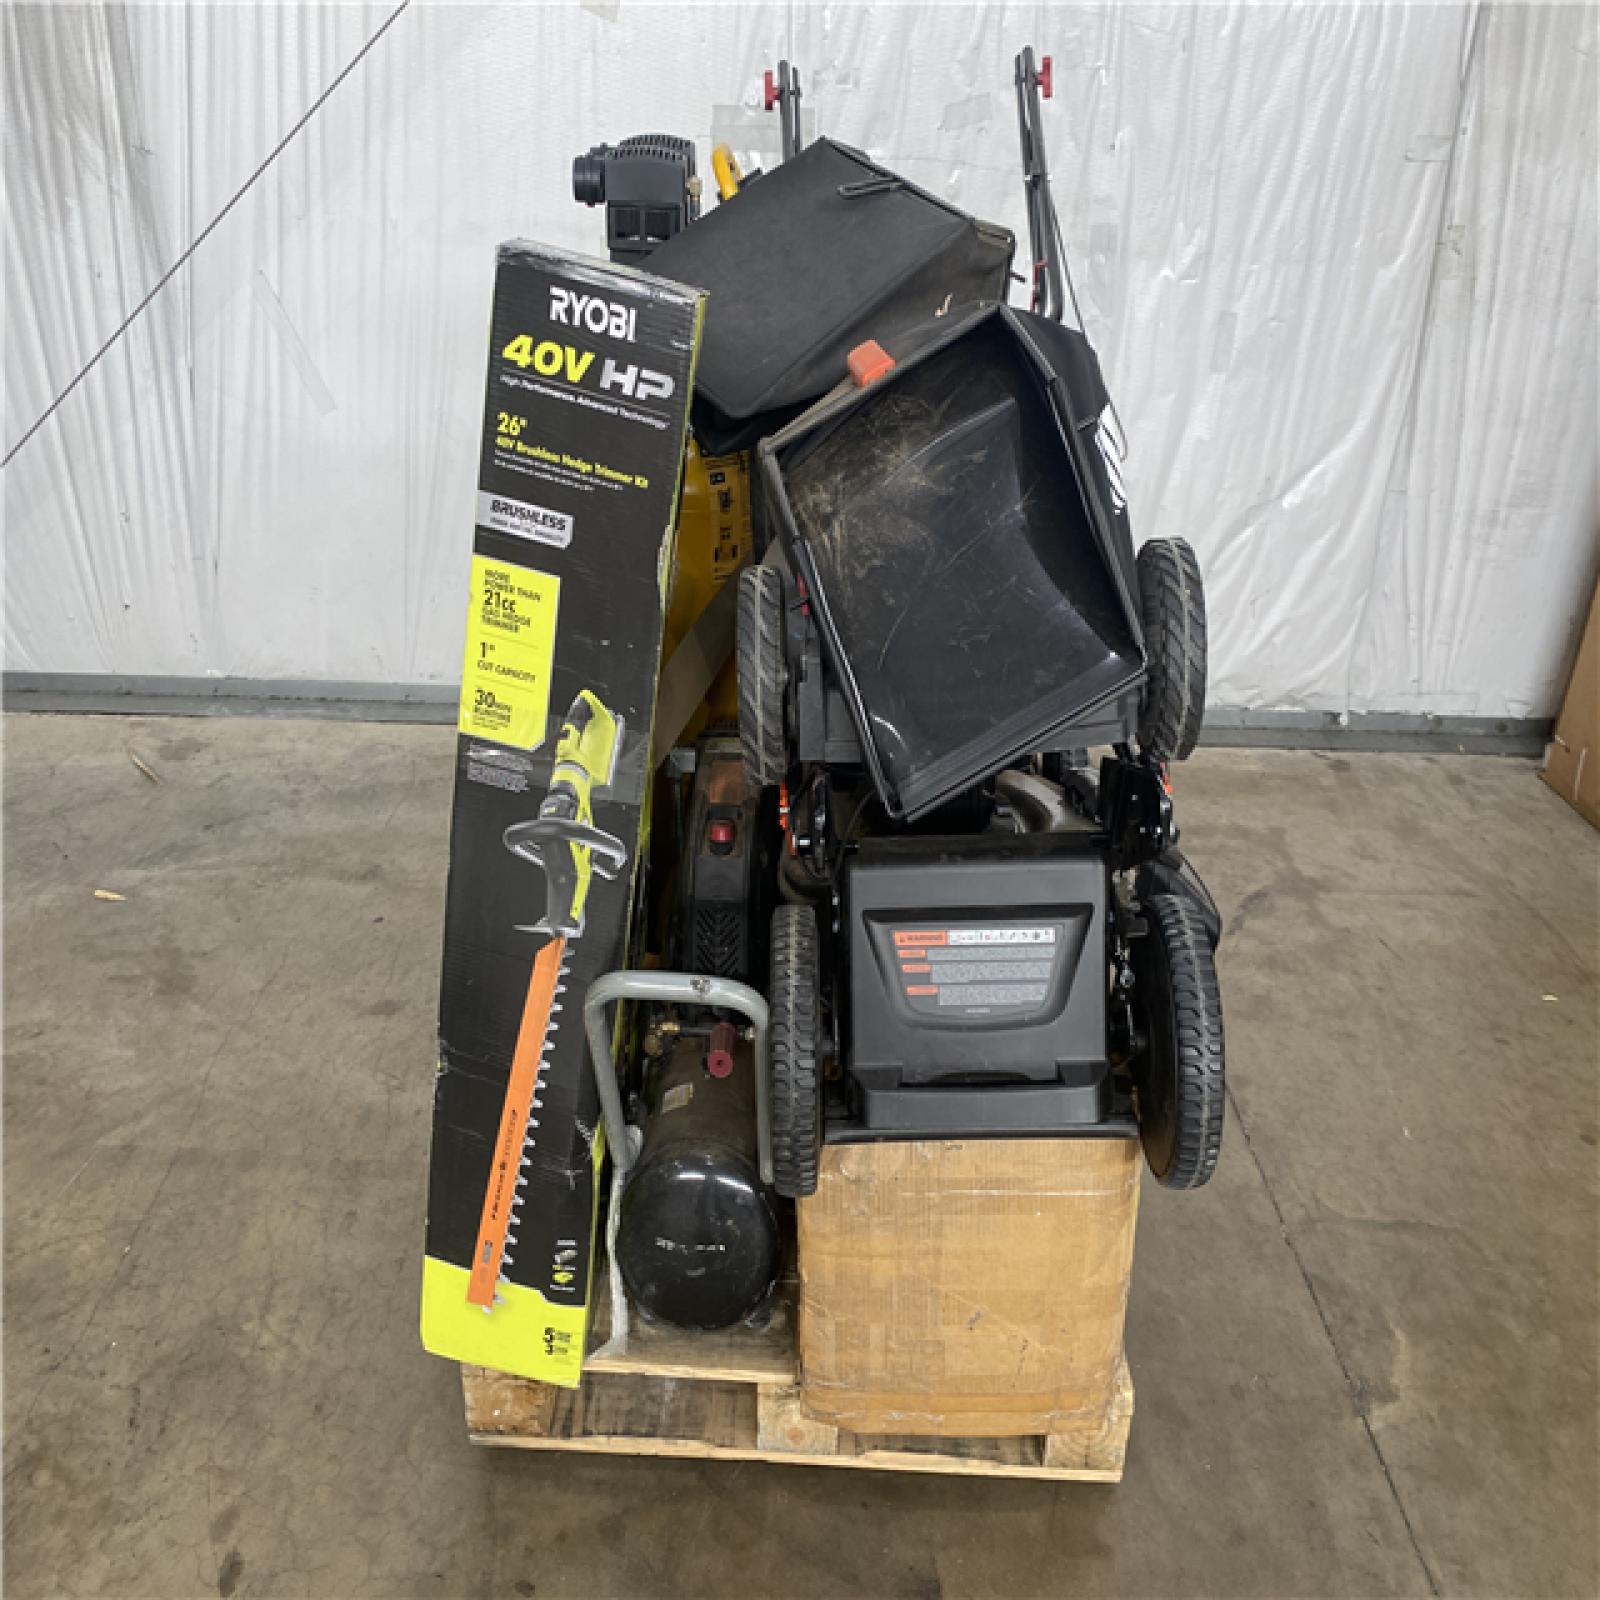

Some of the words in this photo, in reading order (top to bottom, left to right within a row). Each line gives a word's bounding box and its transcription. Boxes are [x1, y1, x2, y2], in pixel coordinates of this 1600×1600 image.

[549, 286, 636, 342] RYOBI
[502, 334, 595, 382] 40V
[599, 358, 675, 400] HP
[490, 499, 566, 531] BRUSHLESS
[516, 587, 541, 602] THAN
[477, 660, 494, 672] CUT
[494, 664, 536, 682] CAPACITY
